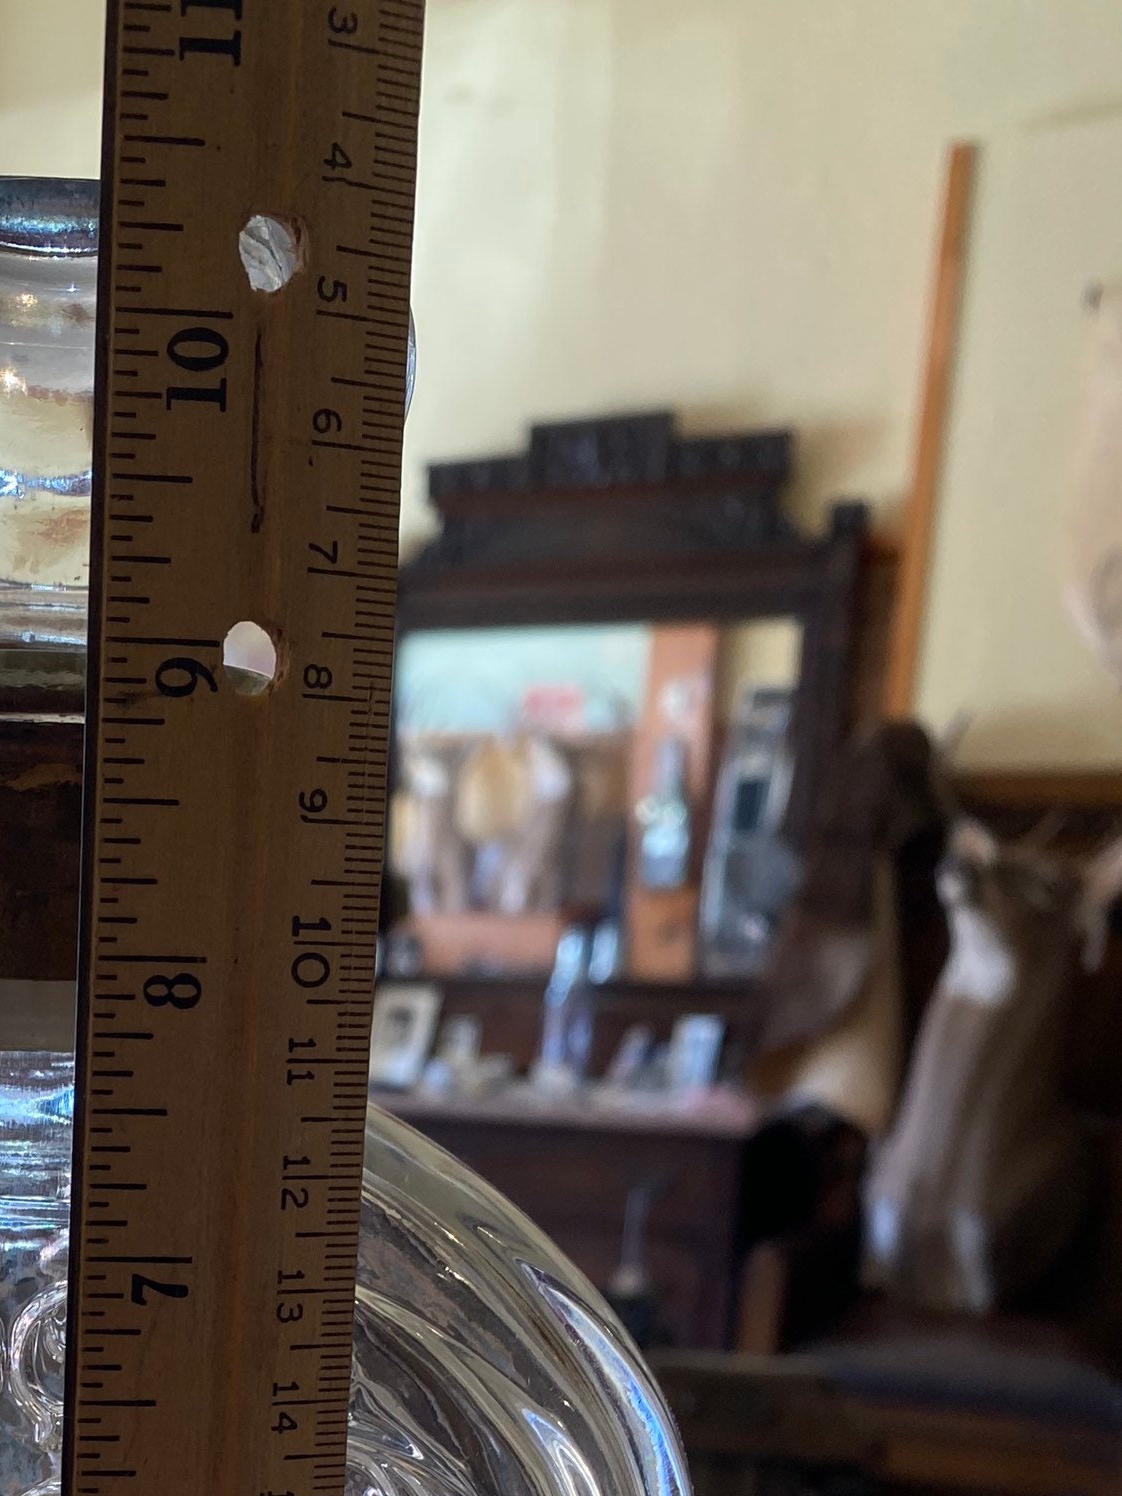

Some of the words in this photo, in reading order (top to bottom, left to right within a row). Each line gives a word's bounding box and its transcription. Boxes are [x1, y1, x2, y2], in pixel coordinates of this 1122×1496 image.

[179, 0, 242, 66] 11
[328, 12, 358, 34] 3
[323, 143, 351, 171] 4
[318, 276, 347, 303] 5
[165, 327, 229, 412] 10
[313, 408, 342, 434] 6
[308, 540, 338, 565] 7
[156, 657, 218, 697] 9
[303, 664, 333, 690] 8
[299, 788, 328, 813] 9
[291, 916, 331, 989] 10
[143, 973, 202, 1010] 8
[286, 1037, 317, 1087] 11
[280, 1154, 311, 1211] 12
[131, 1273, 188, 1306] 7
[277, 1269, 304, 1324] 13
[271, 1381, 299, 1435] 14
